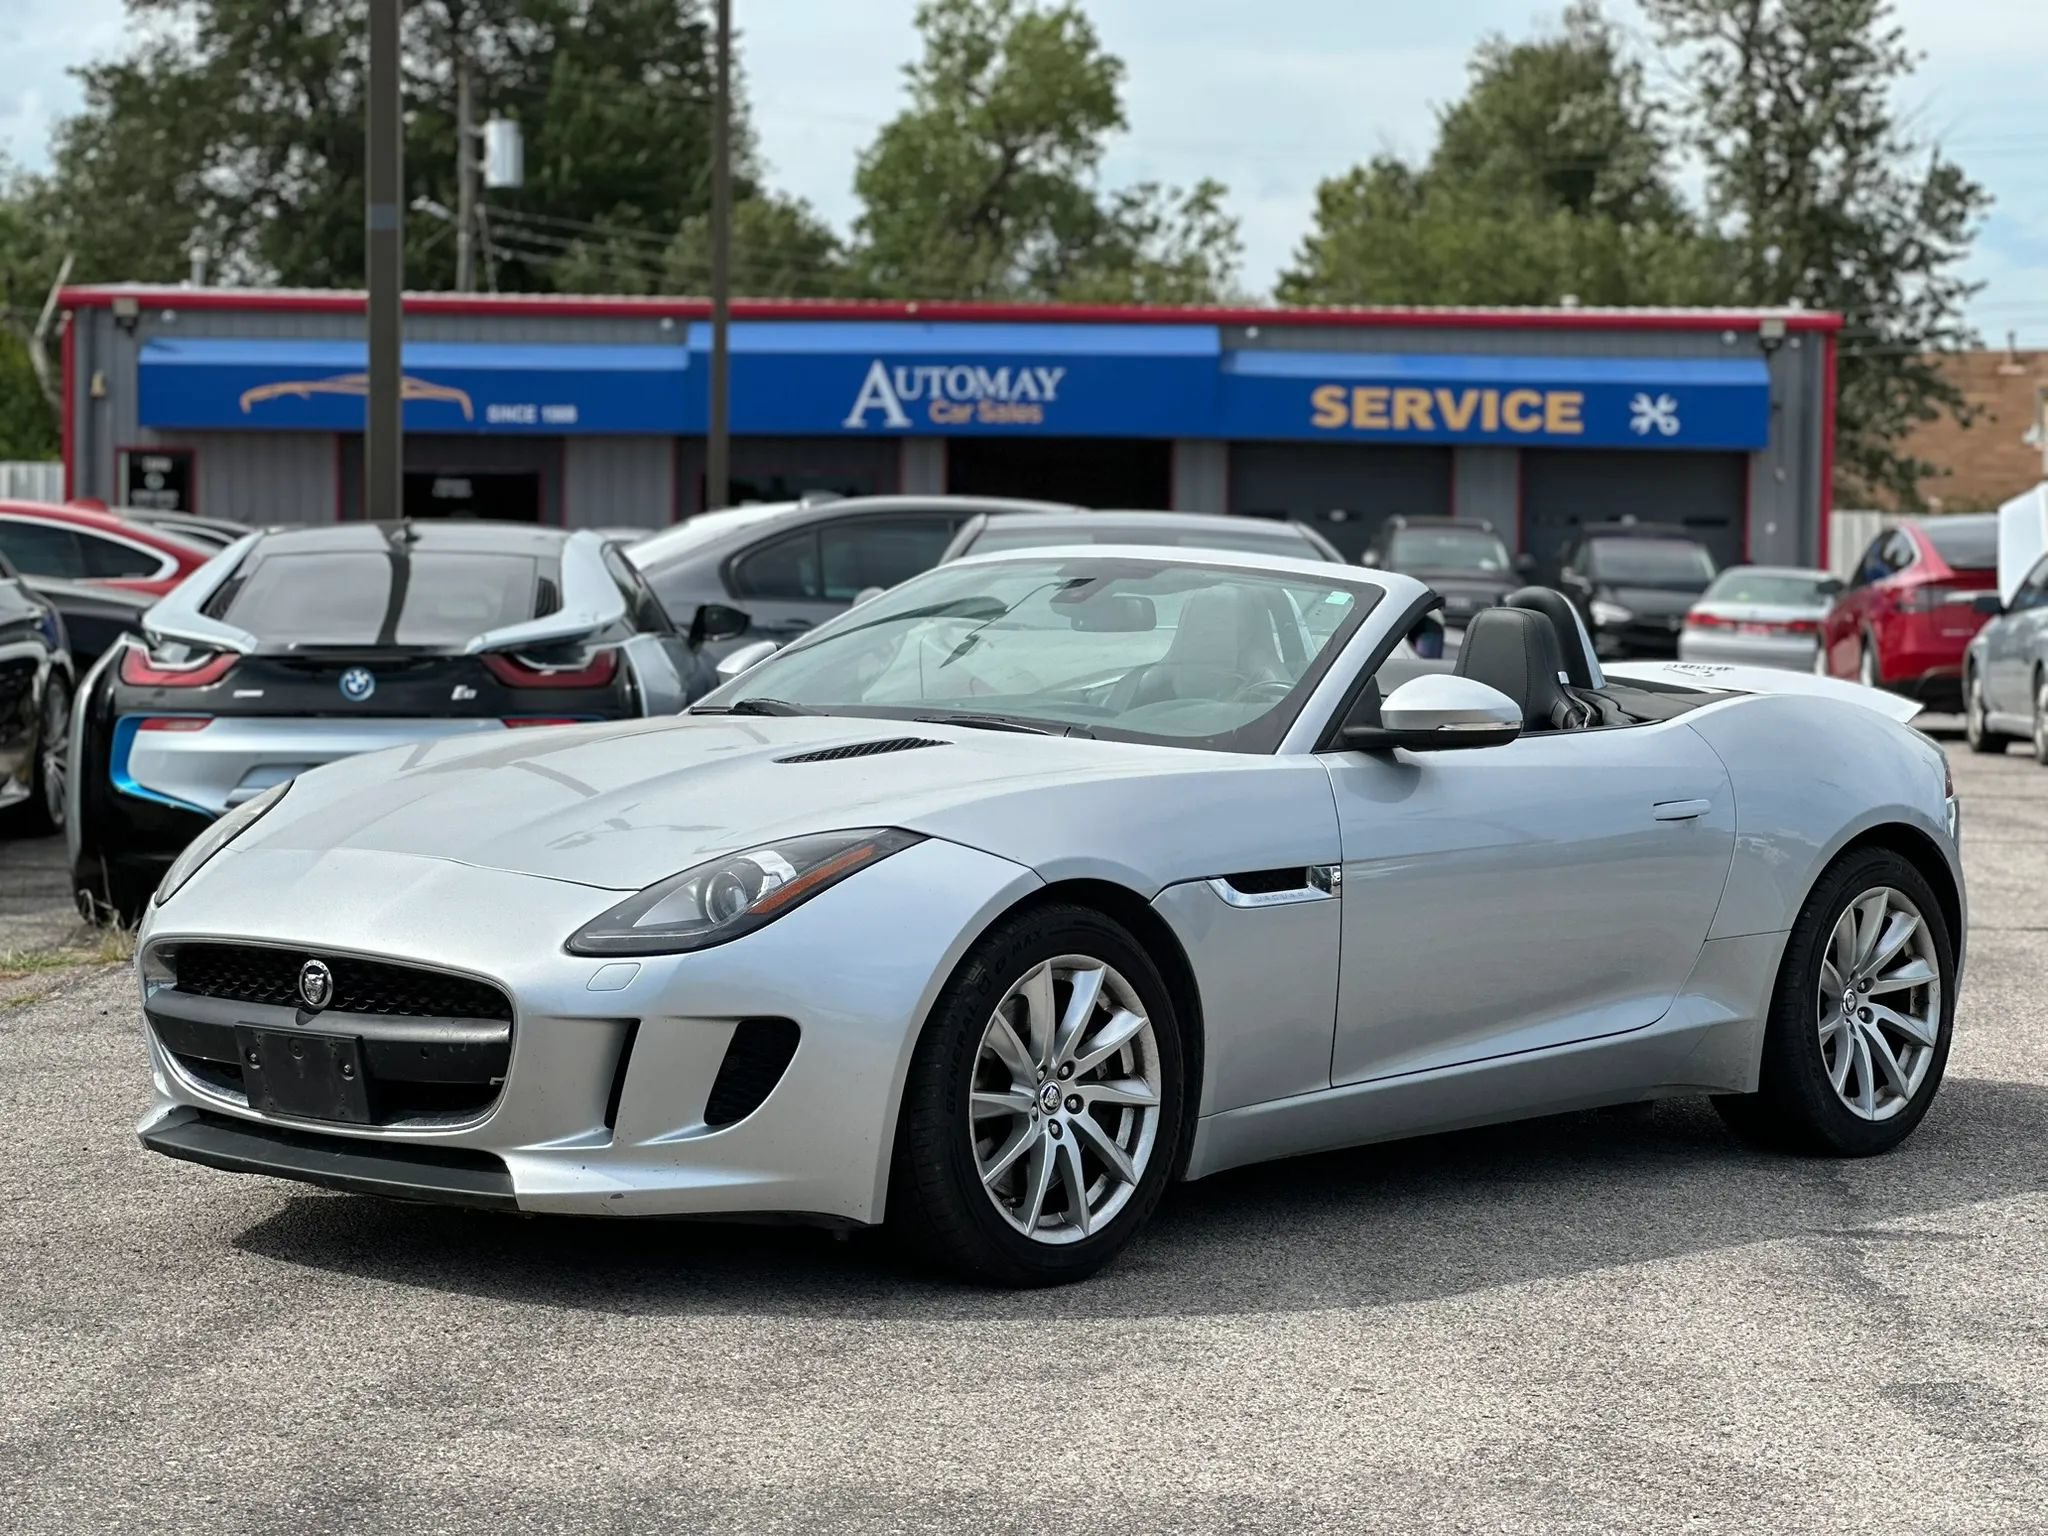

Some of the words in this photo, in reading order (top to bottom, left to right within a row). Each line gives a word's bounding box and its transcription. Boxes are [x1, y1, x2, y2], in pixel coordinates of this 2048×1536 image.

[843, 359, 1066, 428] AUTOMAY
[928, 400, 972, 425] Car
[976, 400, 1044, 425] Sales
[1310, 384, 1585, 435] SERVICE
[486, 404, 538, 424] SINCE
